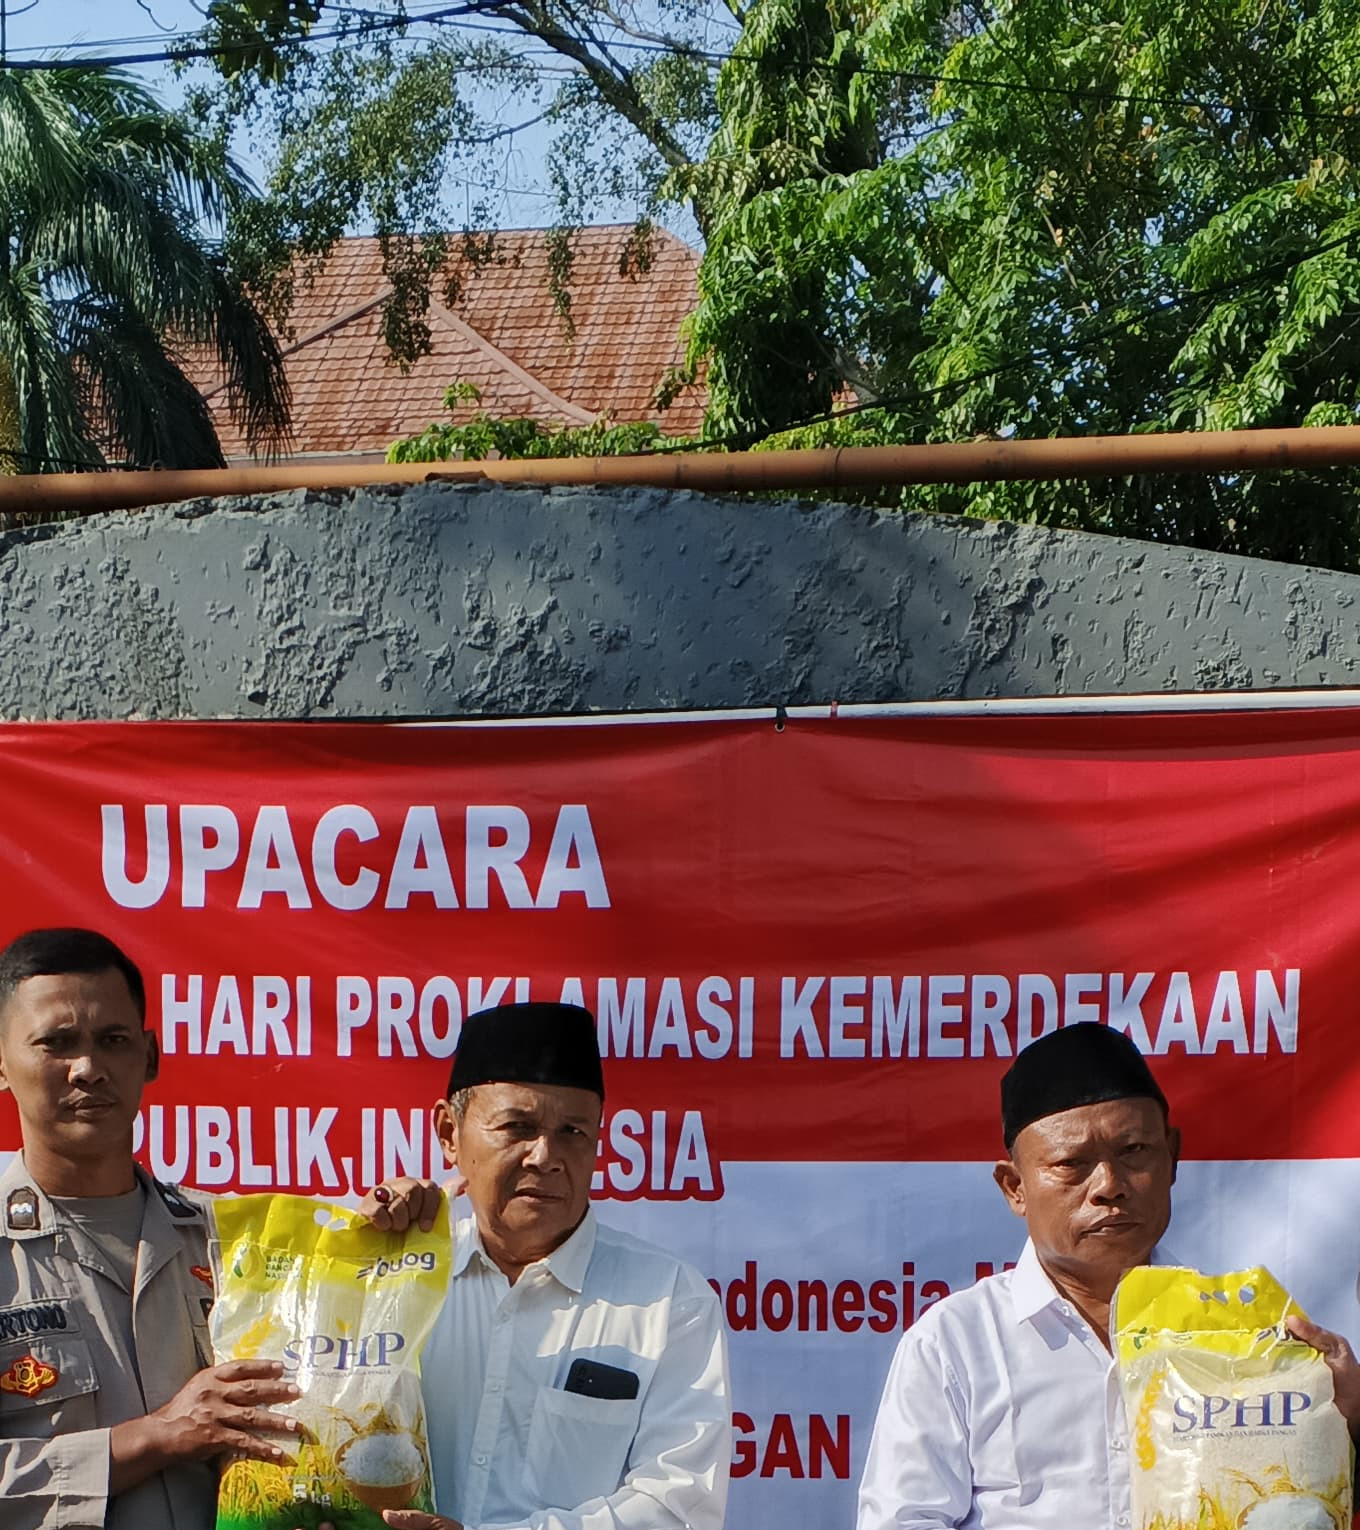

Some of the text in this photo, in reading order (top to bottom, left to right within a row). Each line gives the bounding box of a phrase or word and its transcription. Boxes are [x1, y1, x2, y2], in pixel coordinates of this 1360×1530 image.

[101, 804, 611, 910] UPACARA
[162, 974, 311, 1056] HARI
[283, 1331, 405, 1371] SPHP
[1172, 1391, 1312, 1434] SPHP
[293, 1484, 331, 1506] 5 kg
